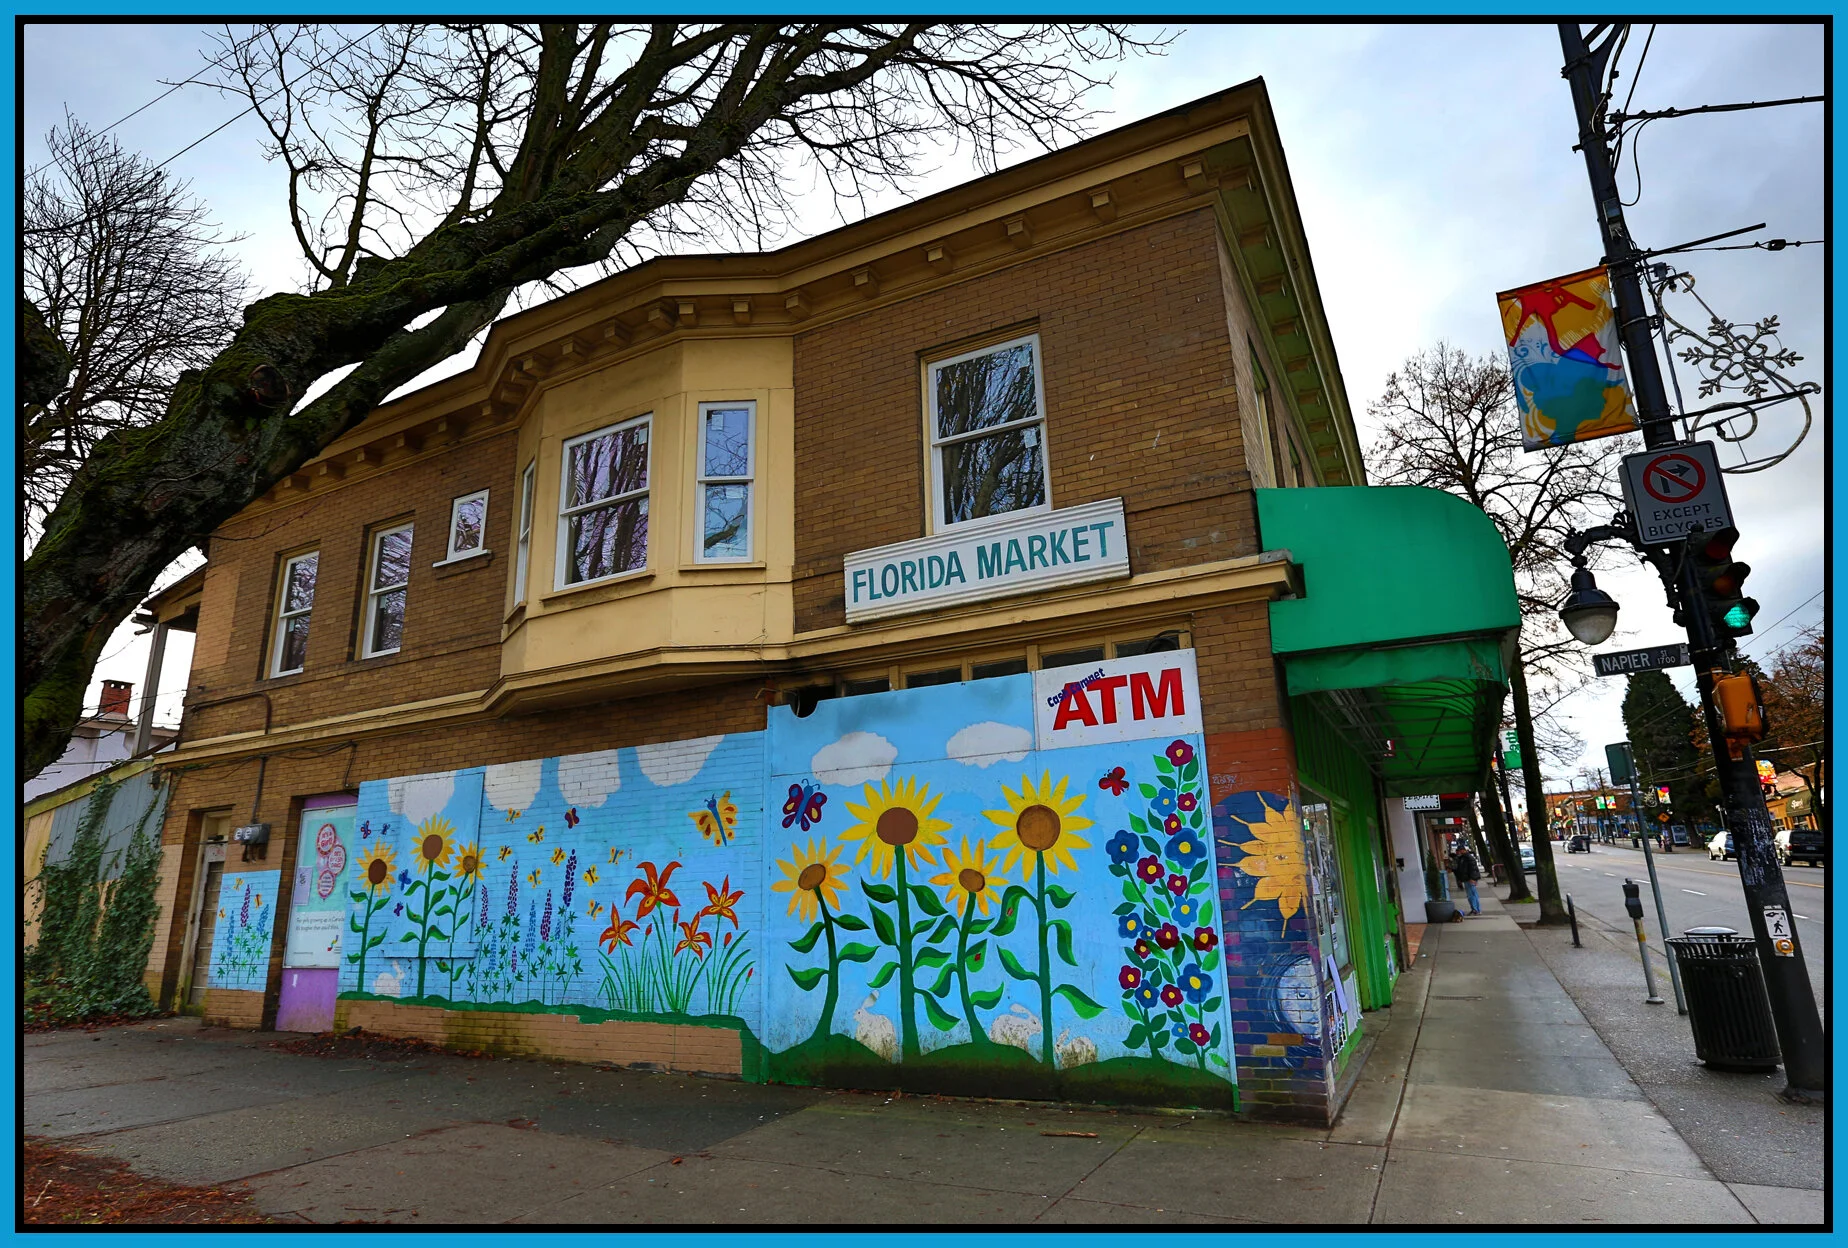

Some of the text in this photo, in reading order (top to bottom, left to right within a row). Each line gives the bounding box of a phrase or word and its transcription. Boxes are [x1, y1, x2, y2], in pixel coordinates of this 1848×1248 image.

[1653, 503, 1711, 521] EXCEPT
[1648, 516, 1724, 537] BICYCES
[852, 520, 1115, 603] FLORIDA MARKET
[1600, 652, 1651, 672] NAPIER
[1657, 656, 1676, 665] 1700
[1052, 667, 1186, 731] ATM
